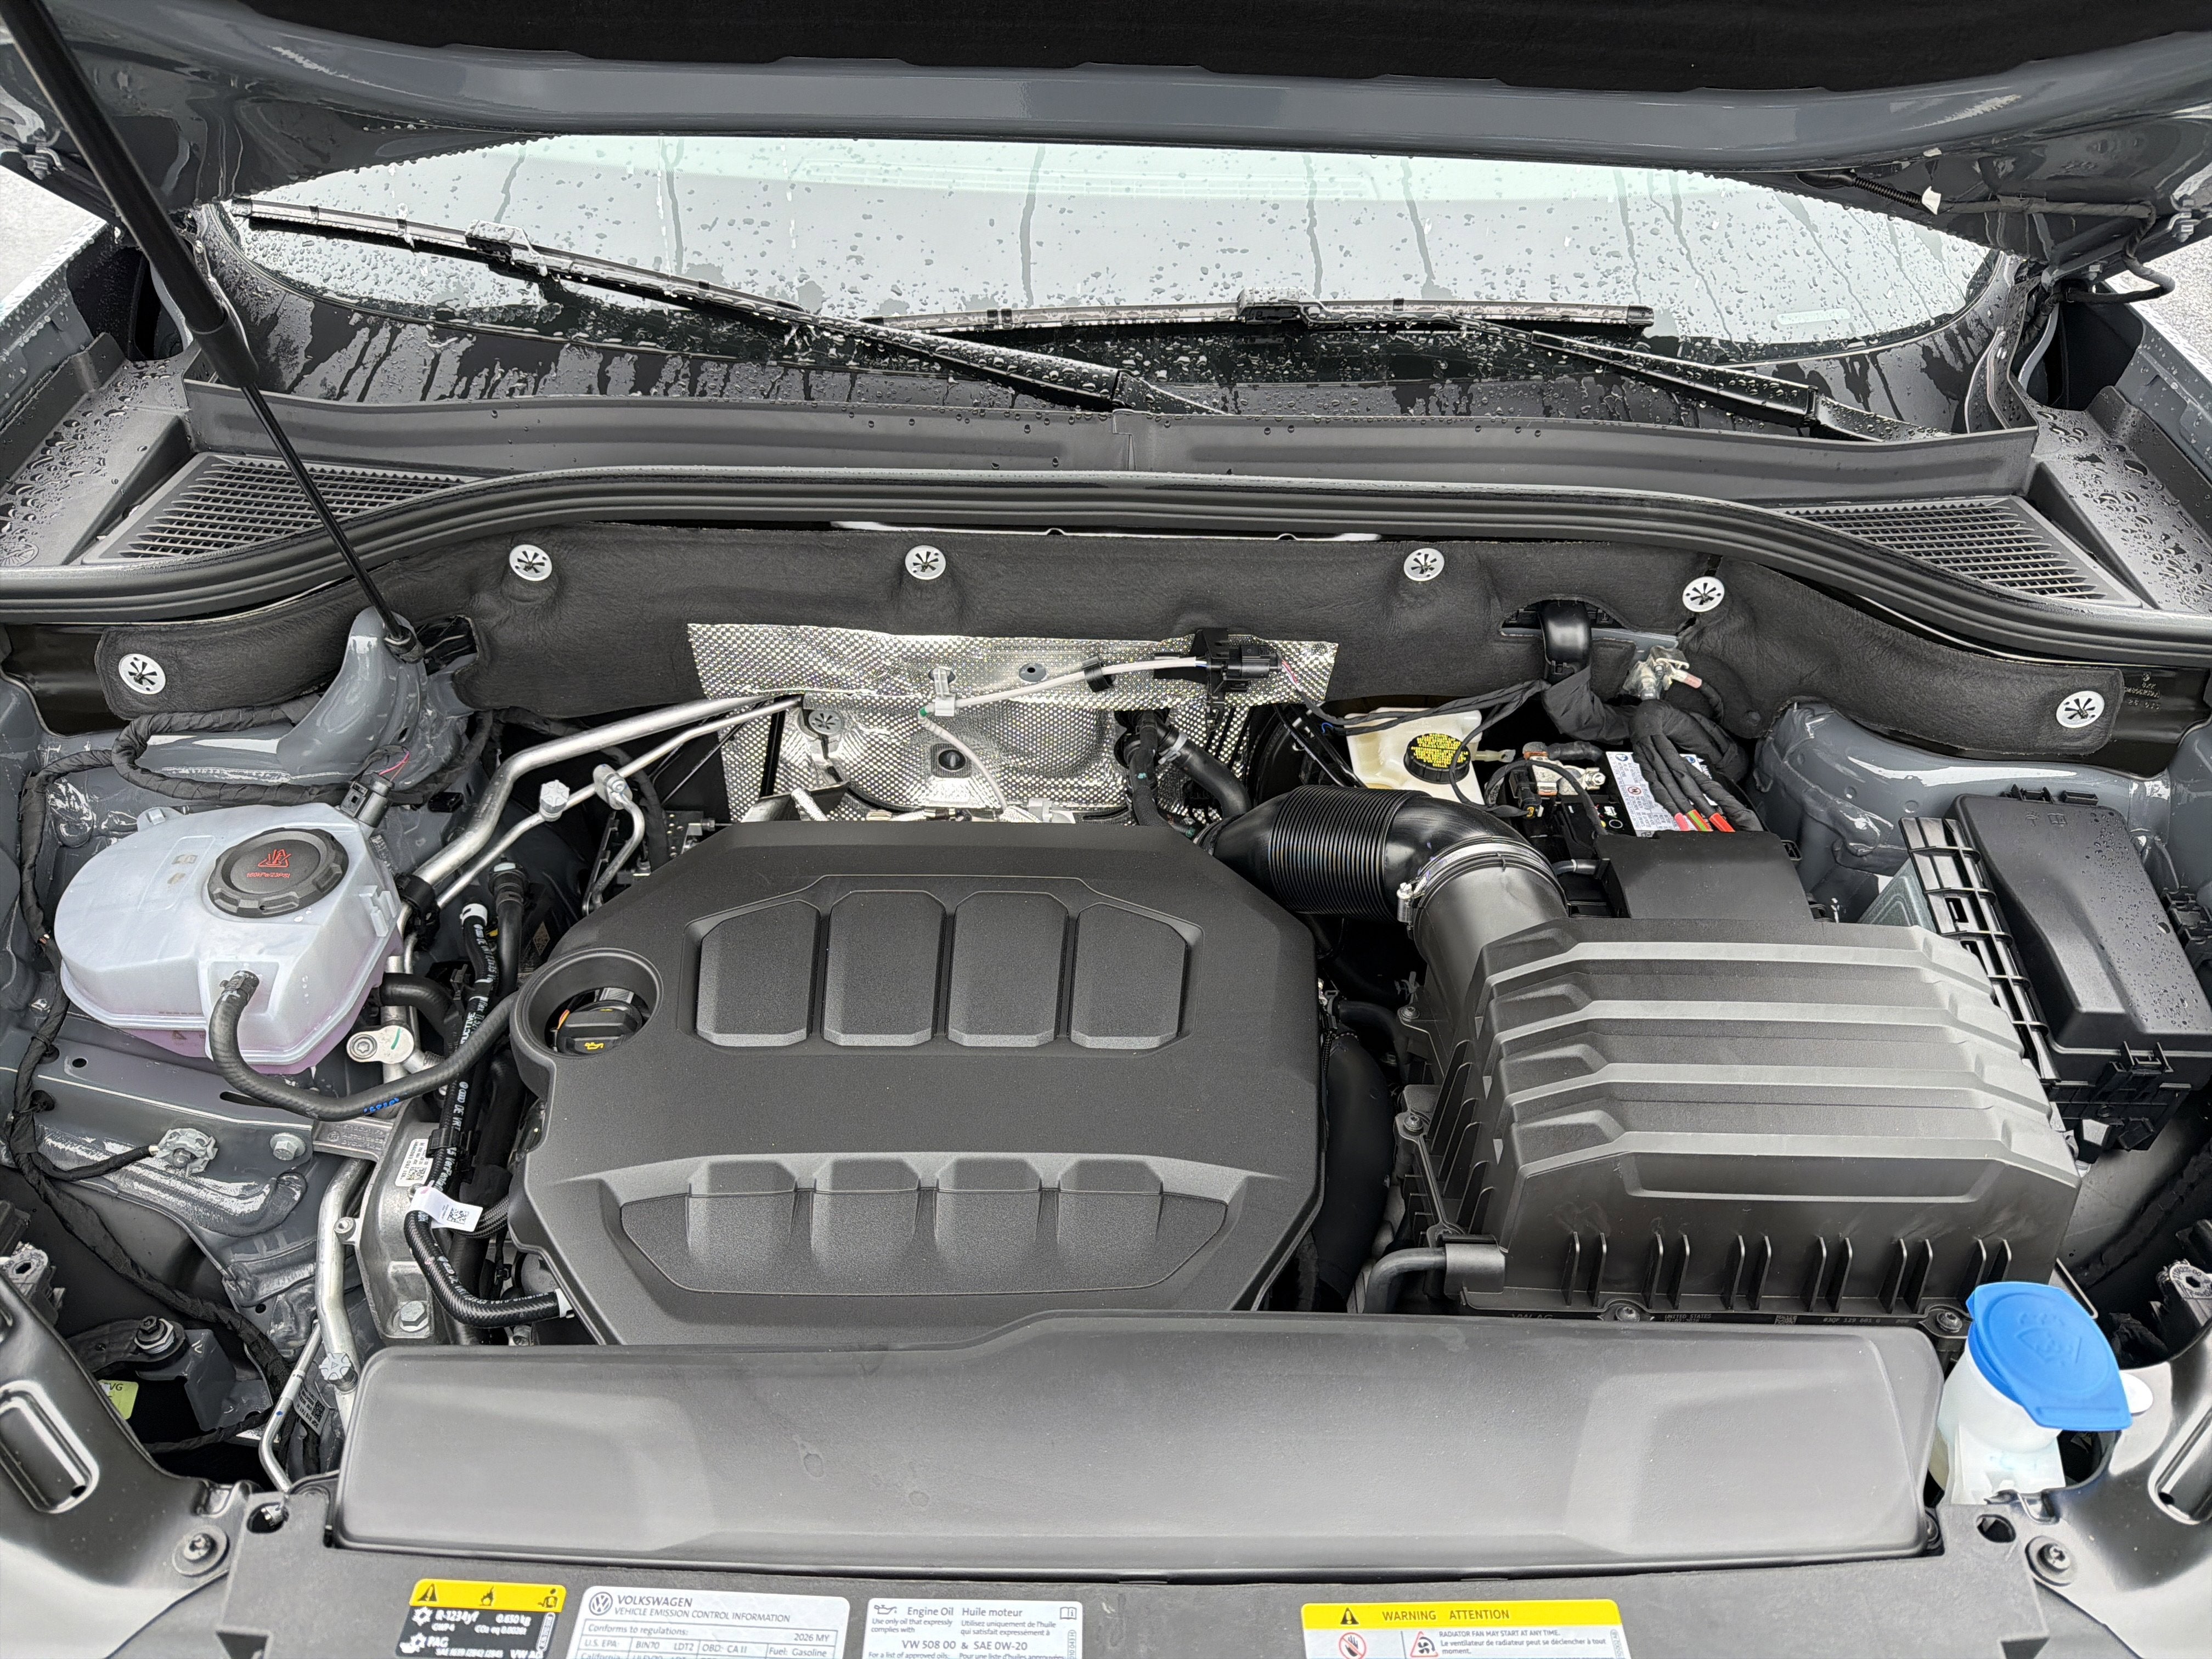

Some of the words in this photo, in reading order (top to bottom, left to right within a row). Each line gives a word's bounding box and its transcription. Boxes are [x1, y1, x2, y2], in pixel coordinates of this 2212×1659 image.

[618, 1595, 692, 1607] VOLKSWAGEN
[615, 1607, 647, 1616] VEHICLE
[650, 1609, 689, 1618] EMISSION
[692, 1610, 729, 1620] CONTROL
[732, 1612, 790, 1622] INFORMATION
[907, 1607, 939, 1618] Engine
[941, 1607, 953, 1616] Oil
[962, 1608, 986, 1616] Huile
[1382, 1611, 1436, 1621] WARNING
[1449, 1610, 1509, 1620] ATTENTION
[589, 1624, 627, 1633] Conforms
[640, 1626, 688, 1636] regulations:
[427, 1637, 449, 1647] PAG
[794, 1633, 814, 1641] 2026
[636, 1641, 660, 1649] BIN70
[727, 1645, 740, 1653] CA
[792, 1649, 827, 1657] Gasoline
[902, 1640, 920, 1649] VW
[922, 1640, 940, 1649] 508
[943, 1640, 956, 1649] 00
[974, 1641, 992, 1650] SAE
[994, 1642, 1028, 1650] 0W-20
[510, 1649, 527, 1658] VW
